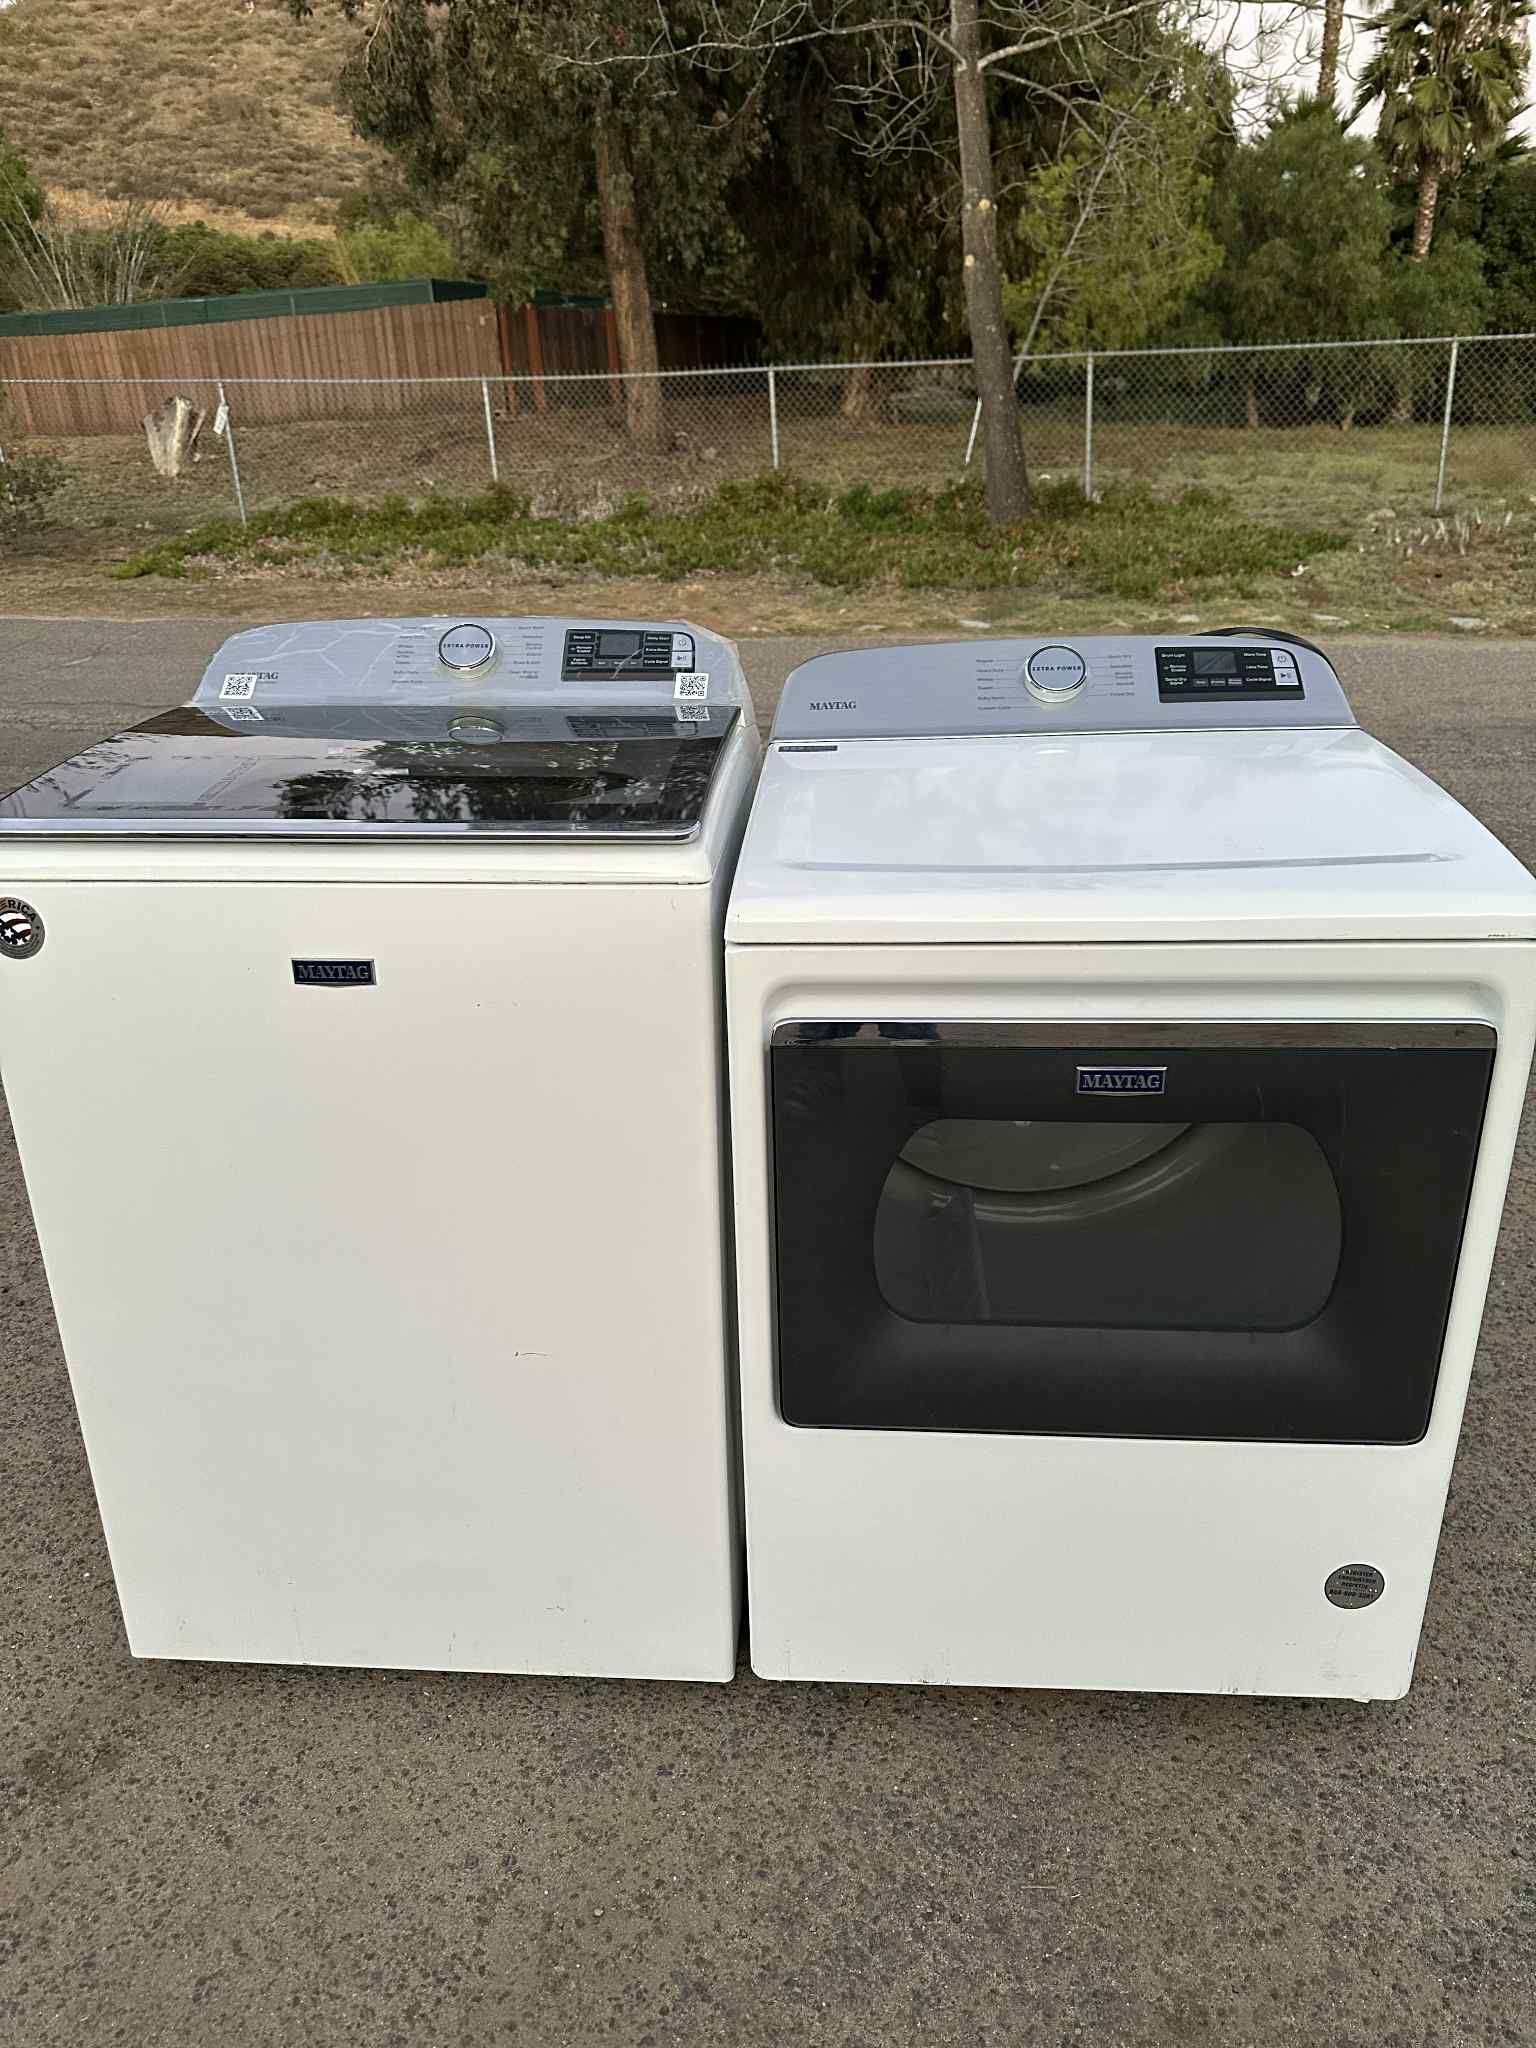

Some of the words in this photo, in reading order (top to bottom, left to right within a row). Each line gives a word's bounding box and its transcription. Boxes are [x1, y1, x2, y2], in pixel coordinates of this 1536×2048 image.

[809, 701, 857, 711] MAYTAG
[297, 965, 369, 979] MAYTAG
[1082, 1074, 1160, 1089] MAYTAG
